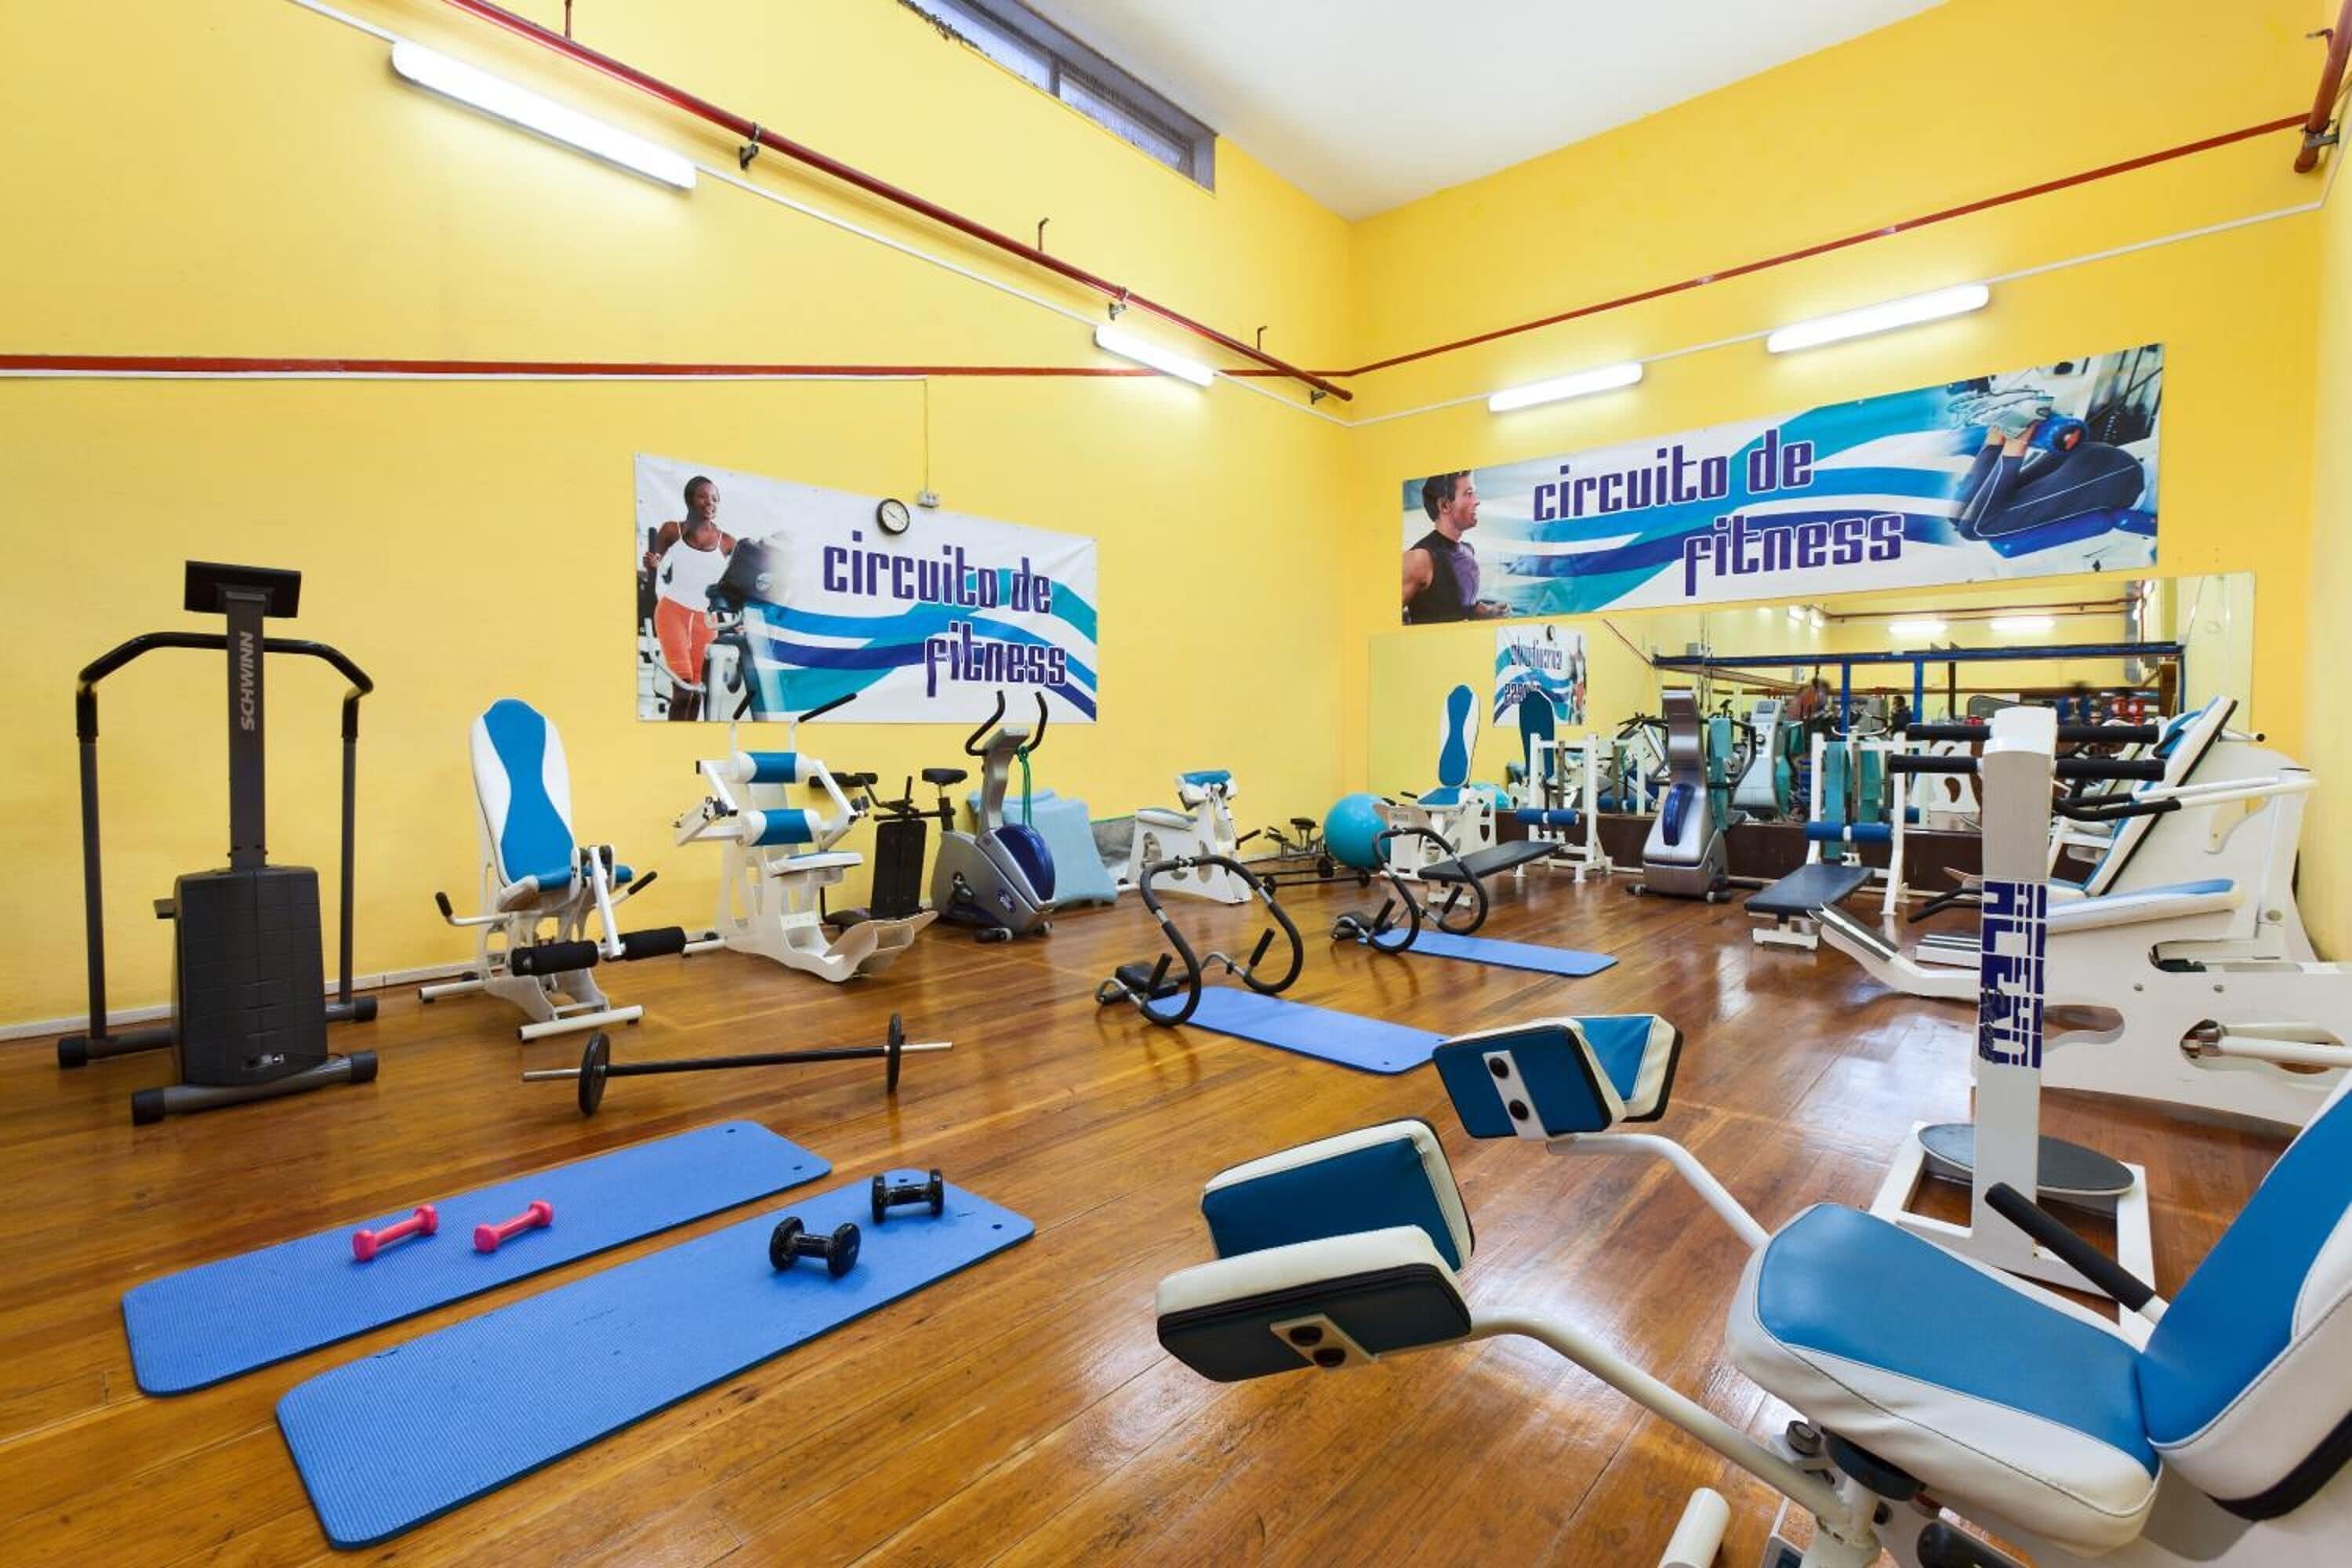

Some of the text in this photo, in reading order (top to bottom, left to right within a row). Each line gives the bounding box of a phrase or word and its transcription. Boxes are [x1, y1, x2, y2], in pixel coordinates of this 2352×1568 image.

[1534, 429, 1813, 521] circuito de
[823, 530, 1051, 613] circuito de
[1685, 514, 1904, 597] fitness
[239, 631, 255, 731] SCHWINN
[926, 622, 1065, 698] fitness
